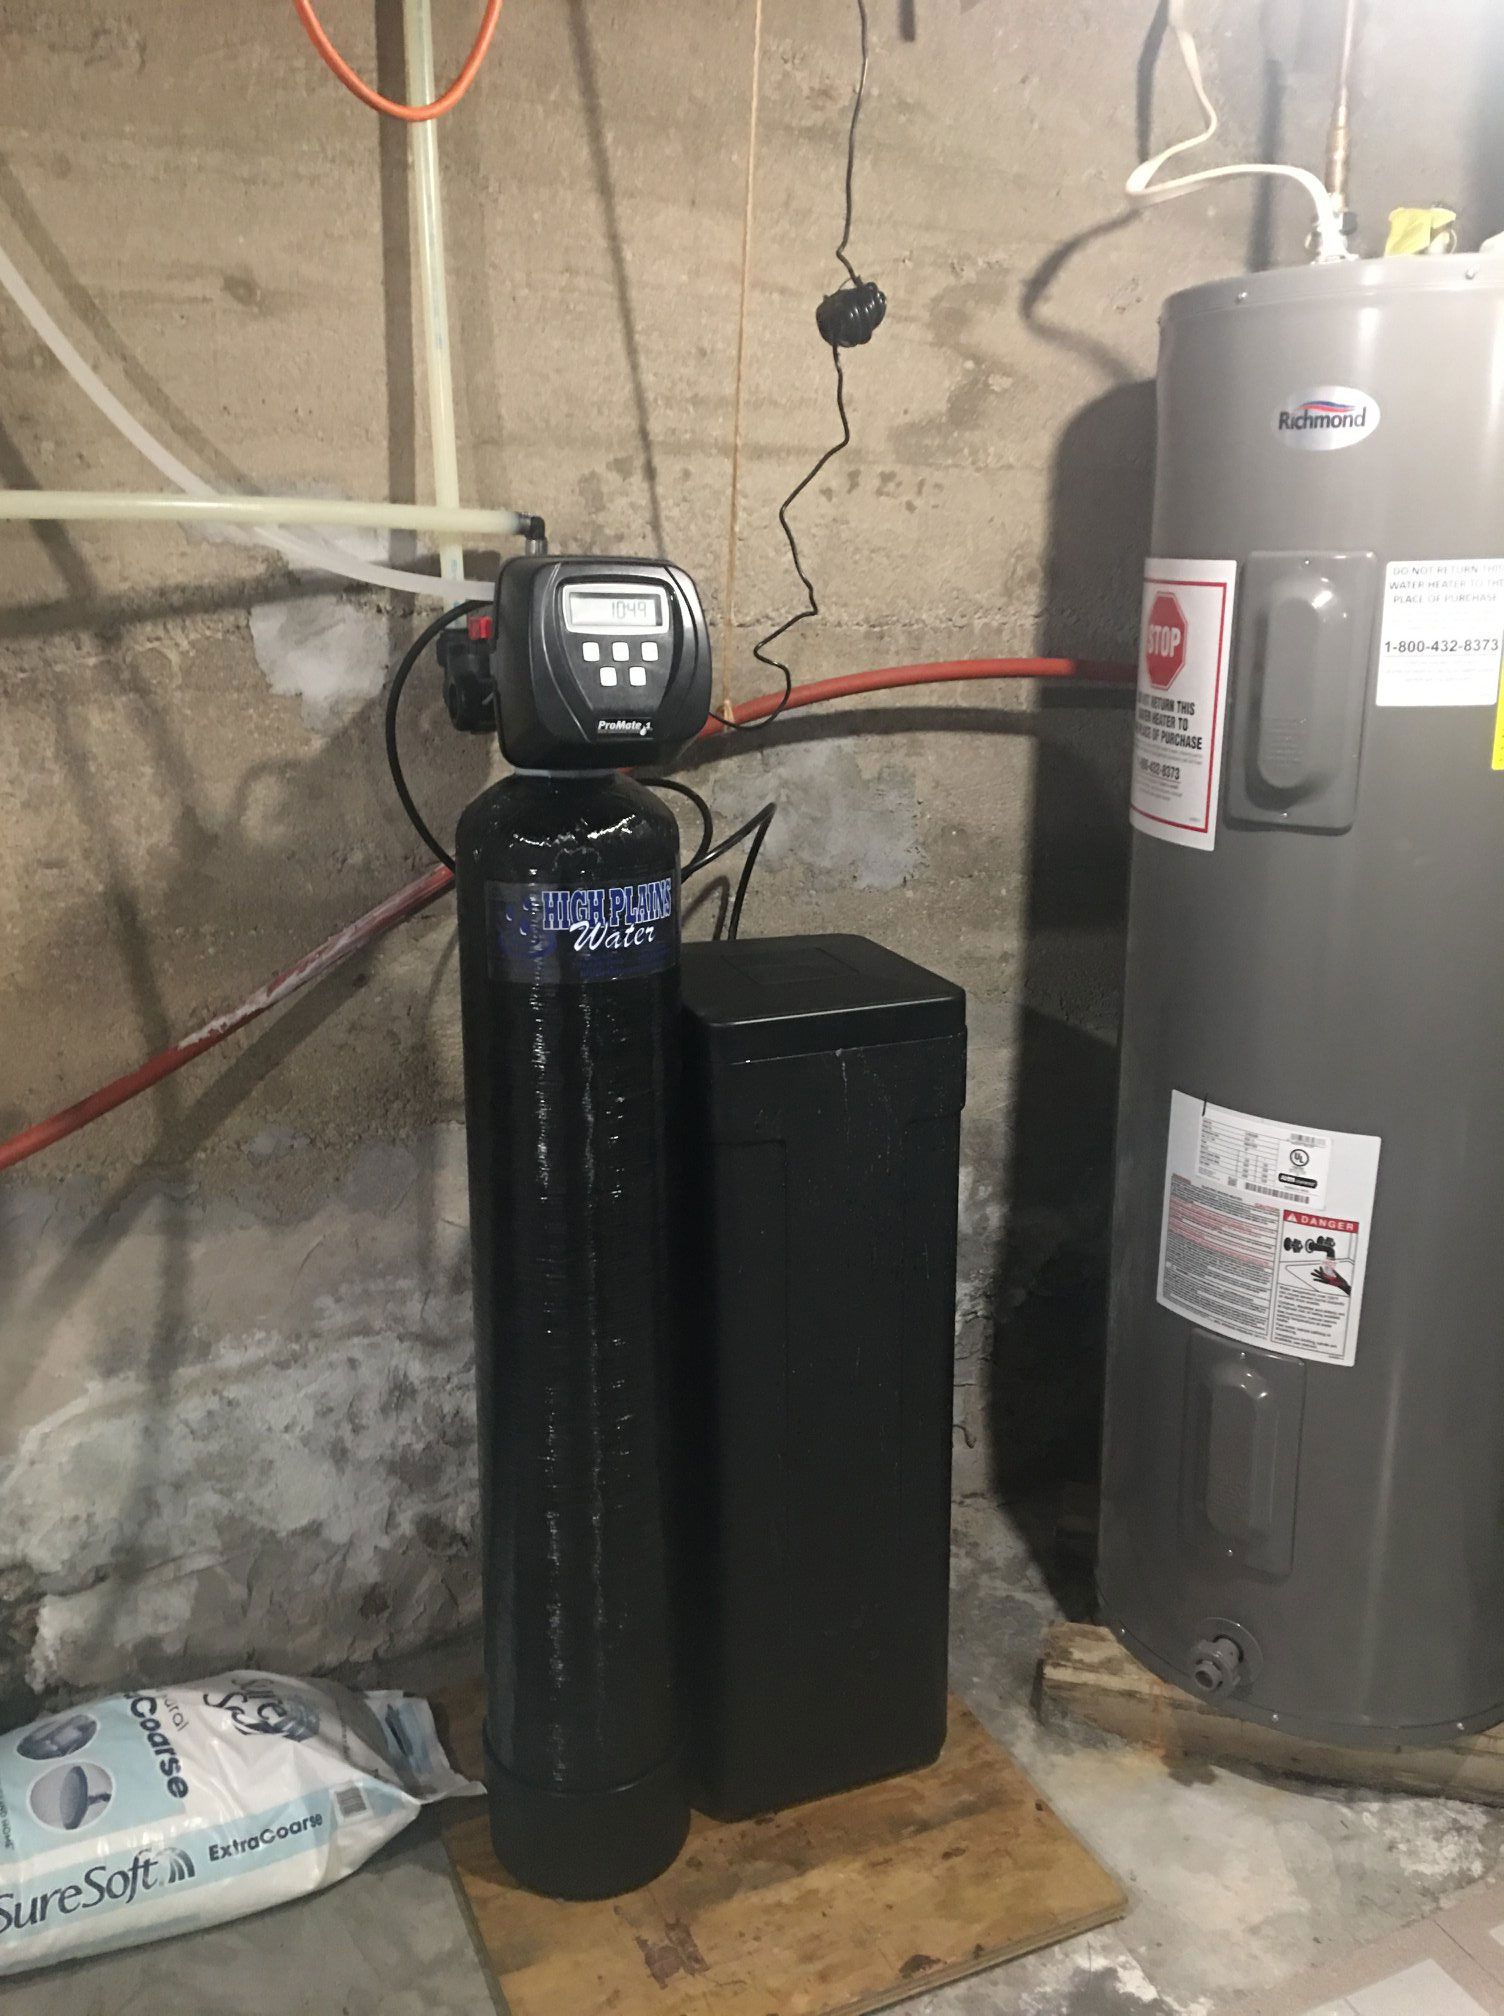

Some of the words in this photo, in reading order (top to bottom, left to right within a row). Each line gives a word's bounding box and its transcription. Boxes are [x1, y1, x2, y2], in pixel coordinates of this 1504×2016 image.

[1278, 406, 1367, 430] Richmond
[1389, 580, 1424, 590] WATER
[1427, 579, 1466, 589] HEATER
[1444, 593, 1497, 603] PURCHASE
[1147, 624, 1181, 658] STOP
[1384, 639, 1499, 653] 1-800-432-8373
[1177, 700, 1195, 716] THIS
[598, 720, 642, 730] ProMate
[1178, 717, 1188, 731] TO
[1161, 730, 1203, 750] PURCHASE
[541, 889, 605, 931] HIGH
[609, 877, 672, 928] PLAINS
[569, 920, 656, 952] Water
[1300, 1215, 1354, 1231] DANGER
[208, 1813, 323, 1862] ExtraCoarse
